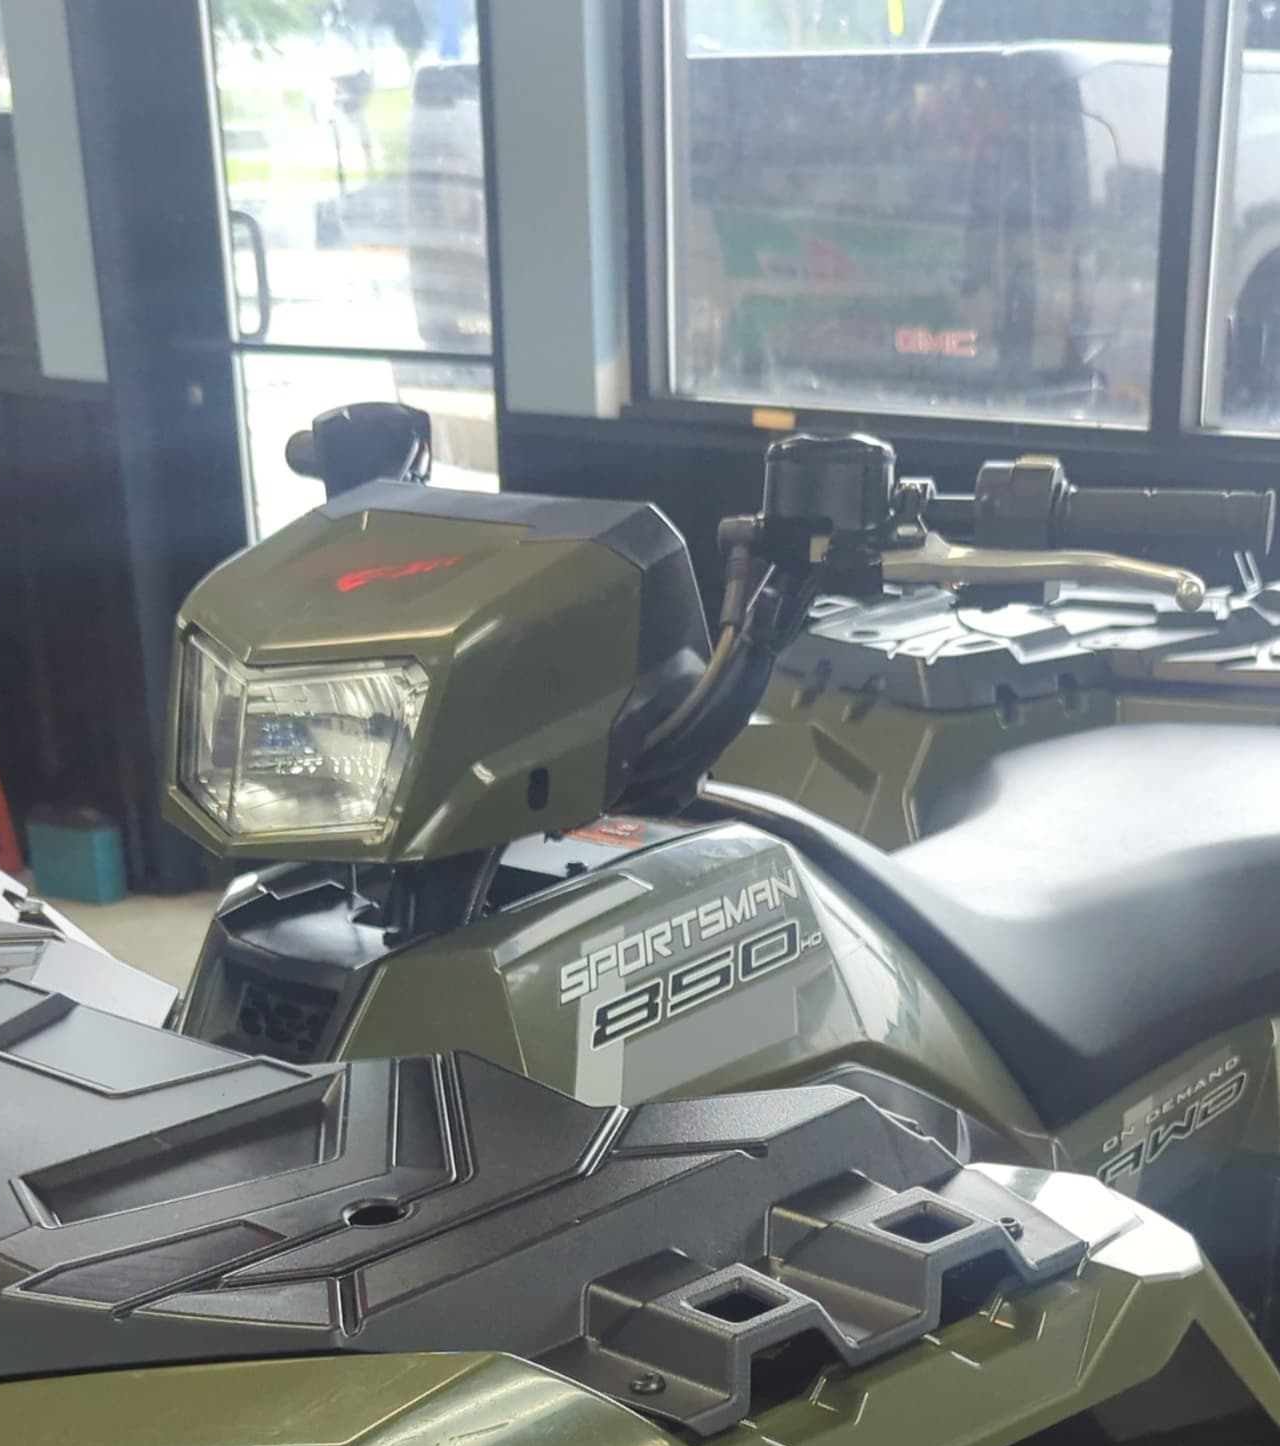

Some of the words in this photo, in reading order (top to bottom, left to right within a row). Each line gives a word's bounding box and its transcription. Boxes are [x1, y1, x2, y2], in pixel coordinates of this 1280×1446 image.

[894, 326, 977, 357] GMC
[560, 867, 799, 1006] SPORTSMAN
[591, 919, 800, 1051] 850
[1096, 1071, 1247, 1185] AWD
[1103, 1125, 1135, 1152] ON
[1146, 1056, 1240, 1124] DEMAND
